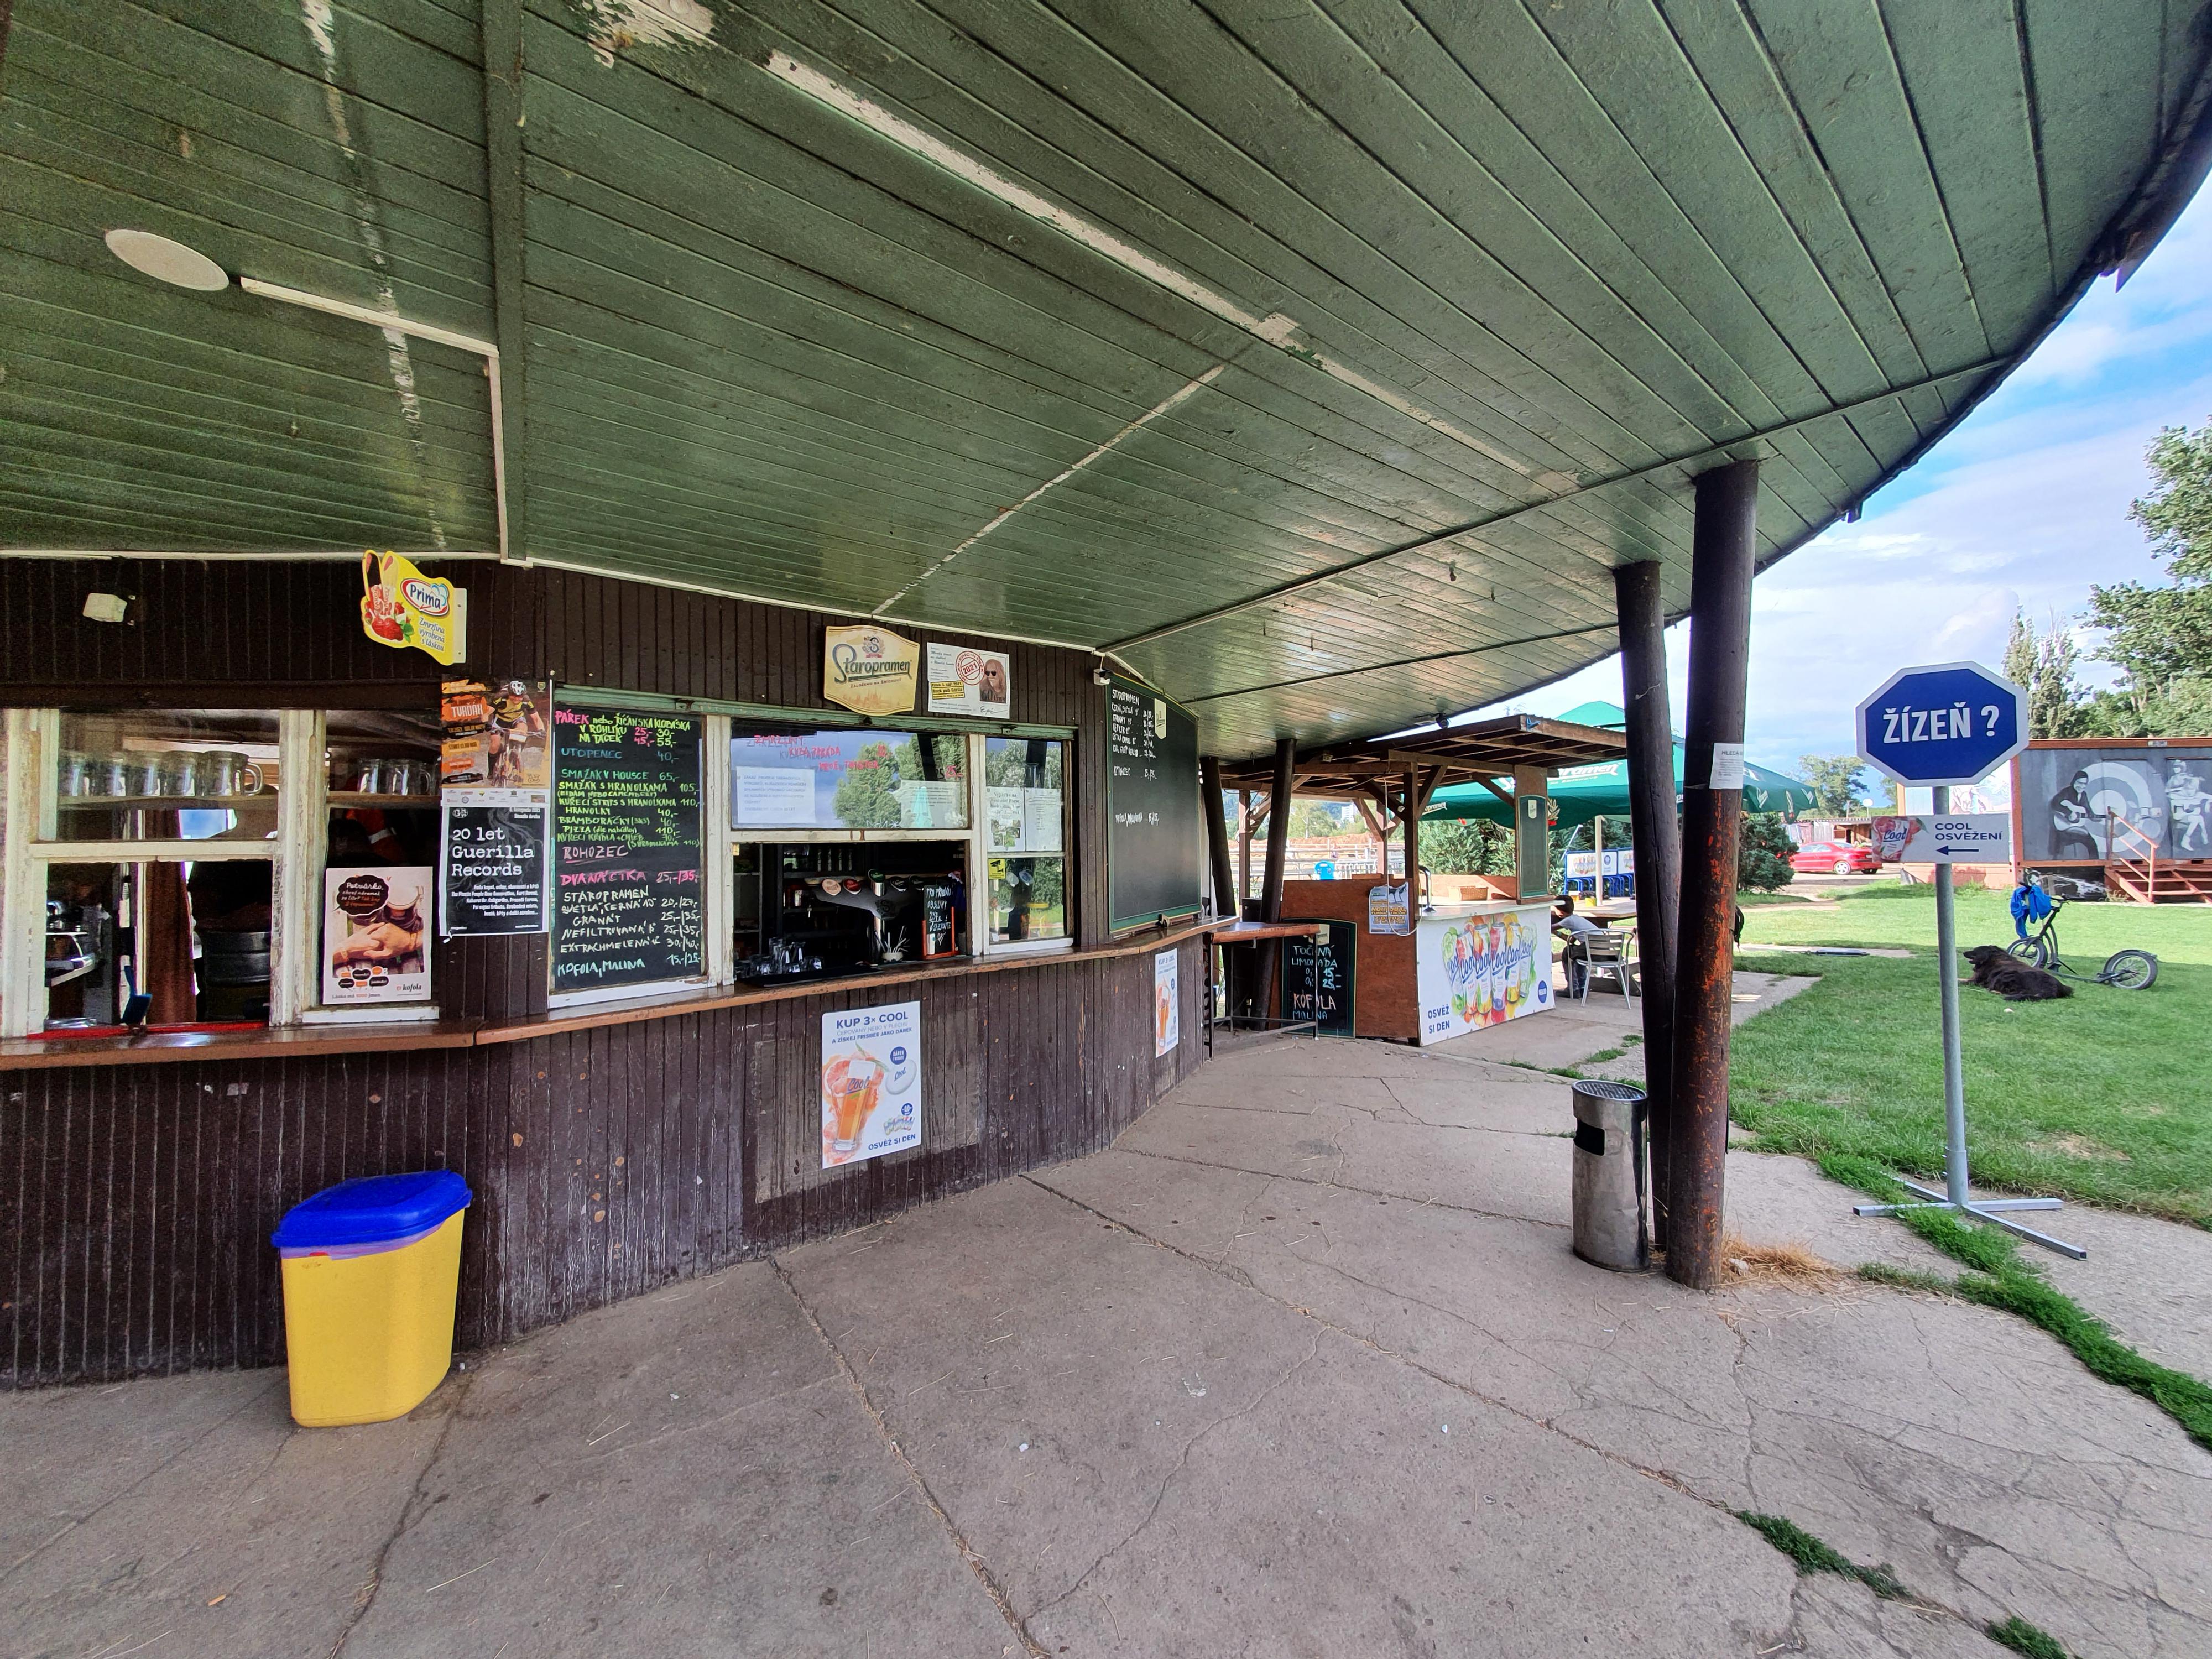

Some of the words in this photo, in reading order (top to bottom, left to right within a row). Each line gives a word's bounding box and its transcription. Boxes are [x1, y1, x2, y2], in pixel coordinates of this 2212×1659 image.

[410, 584, 441, 609] Prima
[419, 617, 445, 634] Zmrzlina
[419, 628, 445, 643] vyrobená
[426, 638, 444, 651] láskou
[832, 644, 912, 685] Staropramen
[963, 662, 978, 674] 2021
[555, 709, 589, 725] PÁREK
[593, 714, 613, 724] nebo
[1882, 701, 1971, 743] ŽÍZEŇ
[1980, 705, 2000, 737] ?
[580, 724, 586, 733] V
[634, 727, 653, 737] 25,-
[656, 728, 675, 739] 30,-
[579, 733, 591, 743] NA
[634, 737, 655, 747] 45,-
[657, 738, 677, 748] 55,-
[561, 748, 623, 759] UTOPENEC
[657, 750, 680, 764] 40,-
[603, 770, 609, 779] V
[613, 770, 650, 780] HOUSCE
[659, 771, 680, 782] 65,-
[559, 779, 597, 791] SMAŽÁK
[607, 782, 668, 792] HRANOLKAMA
[628, 799, 676, 807] HRANOLKAMA
[565, 806, 611, 815] HRANOLKY
[658, 808, 679, 818] 40,-
[452, 828, 471, 841] 20
[476, 827, 505, 841] let
[1935, 822, 1973, 831] COOL
[1882, 827, 1908, 843] Cool
[1935, 831, 2003, 841] OSVĚŽENÍ
[452, 844, 535, 859] Guerilla
[562, 845, 629, 859] ROHOZEC
[451, 862, 523, 877] Records
[560, 869, 646, 886] DVANÁCTKA
[564, 885, 649, 904] STAROPRAMEN
[573, 913, 621, 927] GRANÁT
[561, 920, 646, 941] NEFILTROVANÁ
[403, 983, 422, 992] kofola
[1428, 1004, 1450, 1019] OSVĚŽ
[836, 1018, 860, 1029] KUP
[879, 1011, 909, 1023] COOL
[1429, 1025, 1435, 1034] SI
[1437, 1020, 1450, 1032] DEN
[846, 1076, 870, 1095] Cool
[868, 1138, 892, 1150] OSVĚŽ
[902, 1134, 916, 1143] DEN
